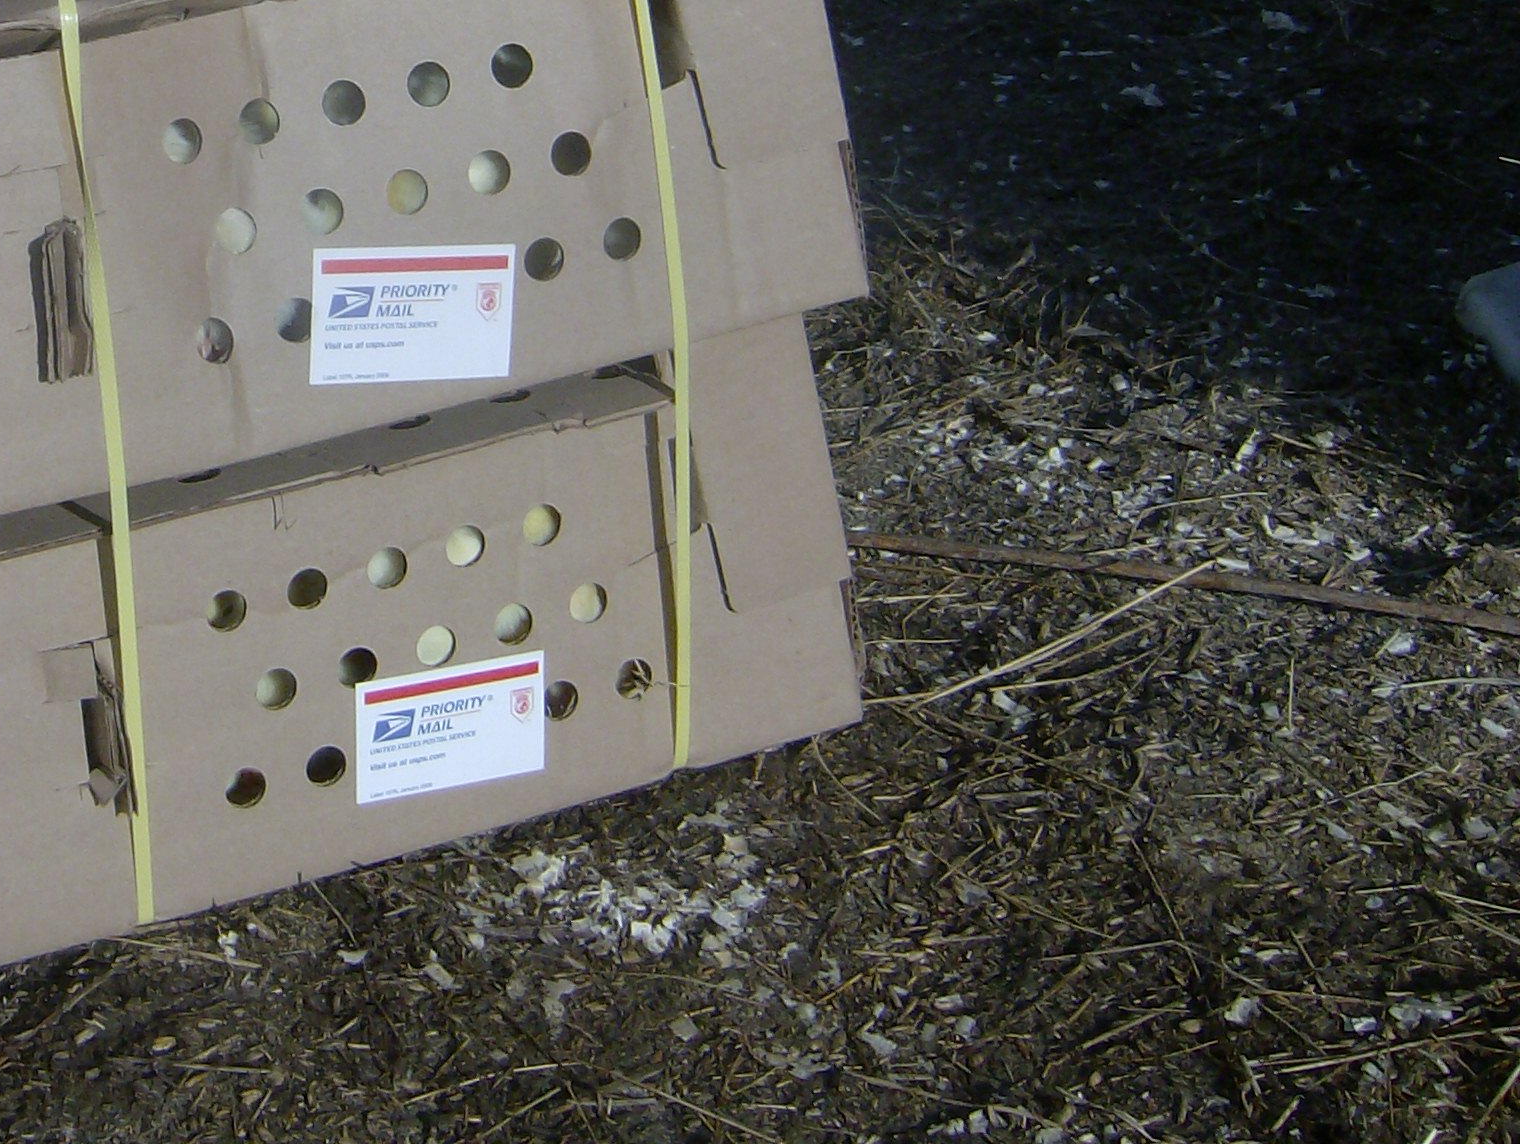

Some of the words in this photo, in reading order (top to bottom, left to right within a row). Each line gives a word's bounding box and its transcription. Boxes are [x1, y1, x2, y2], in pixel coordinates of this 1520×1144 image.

[380, 284, 450, 298] PRIORITY
[376, 304, 415, 317] MAIL
[380, 322, 407, 330] POSTAL
[408, 321, 438, 329] SERVICE
[324, 342, 342, 350] Visit
[355, 341, 364, 349] at
[421, 695, 487, 718] PRIORITY
[417, 718, 454, 736] MAIL
[370, 745, 397, 755] UNITED
